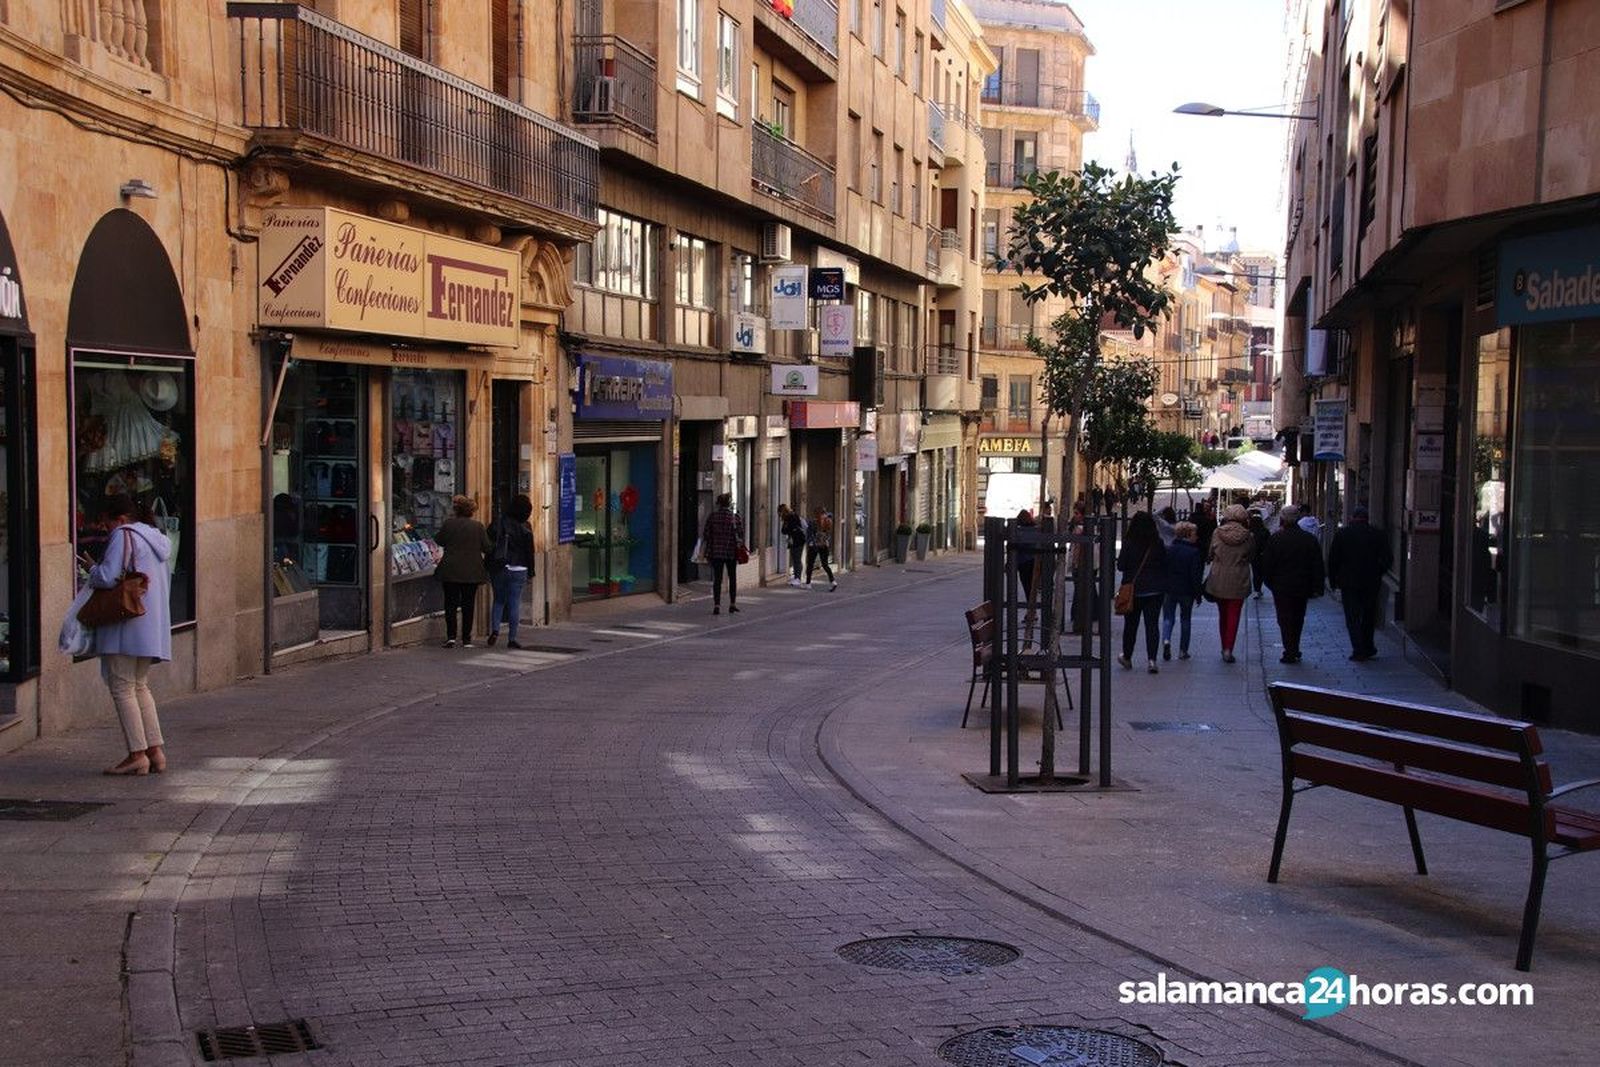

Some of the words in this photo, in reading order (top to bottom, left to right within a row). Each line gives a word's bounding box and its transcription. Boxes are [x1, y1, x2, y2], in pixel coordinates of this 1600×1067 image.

[262, 235, 323, 298] Fernandez
[334, 222, 420, 273] Pañerías
[264, 303, 321, 323] Confecciones
[335, 268, 420, 321] Confecciones
[427, 254, 514, 328] Fernandez
[816, 284, 841, 294] MGS
